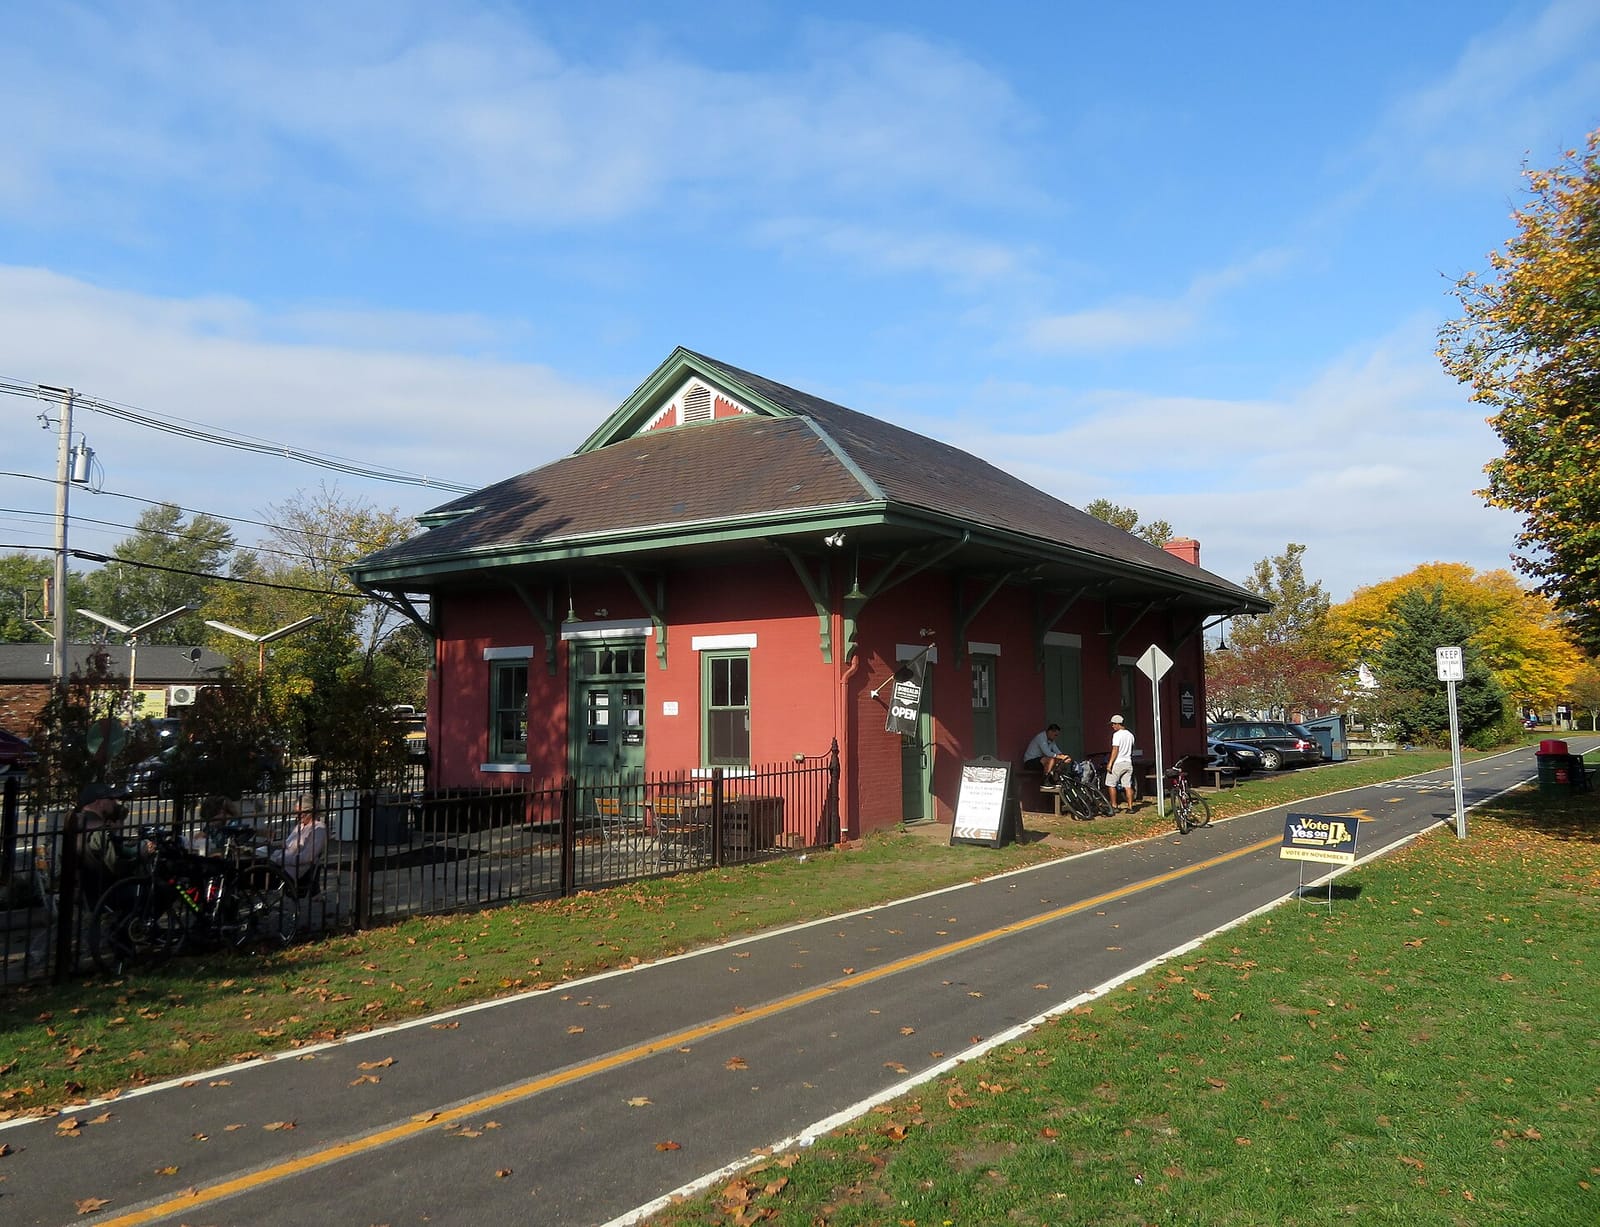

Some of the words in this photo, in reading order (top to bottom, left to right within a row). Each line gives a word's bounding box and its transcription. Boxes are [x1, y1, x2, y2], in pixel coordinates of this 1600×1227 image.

[1440, 650, 1458, 659] KEEP
[891, 705, 917, 720] OPEN
[1300, 818, 1329, 830] Vote
[1289, 825, 1314, 838] Yes
[1310, 852, 1344, 860] NOVEMBER
